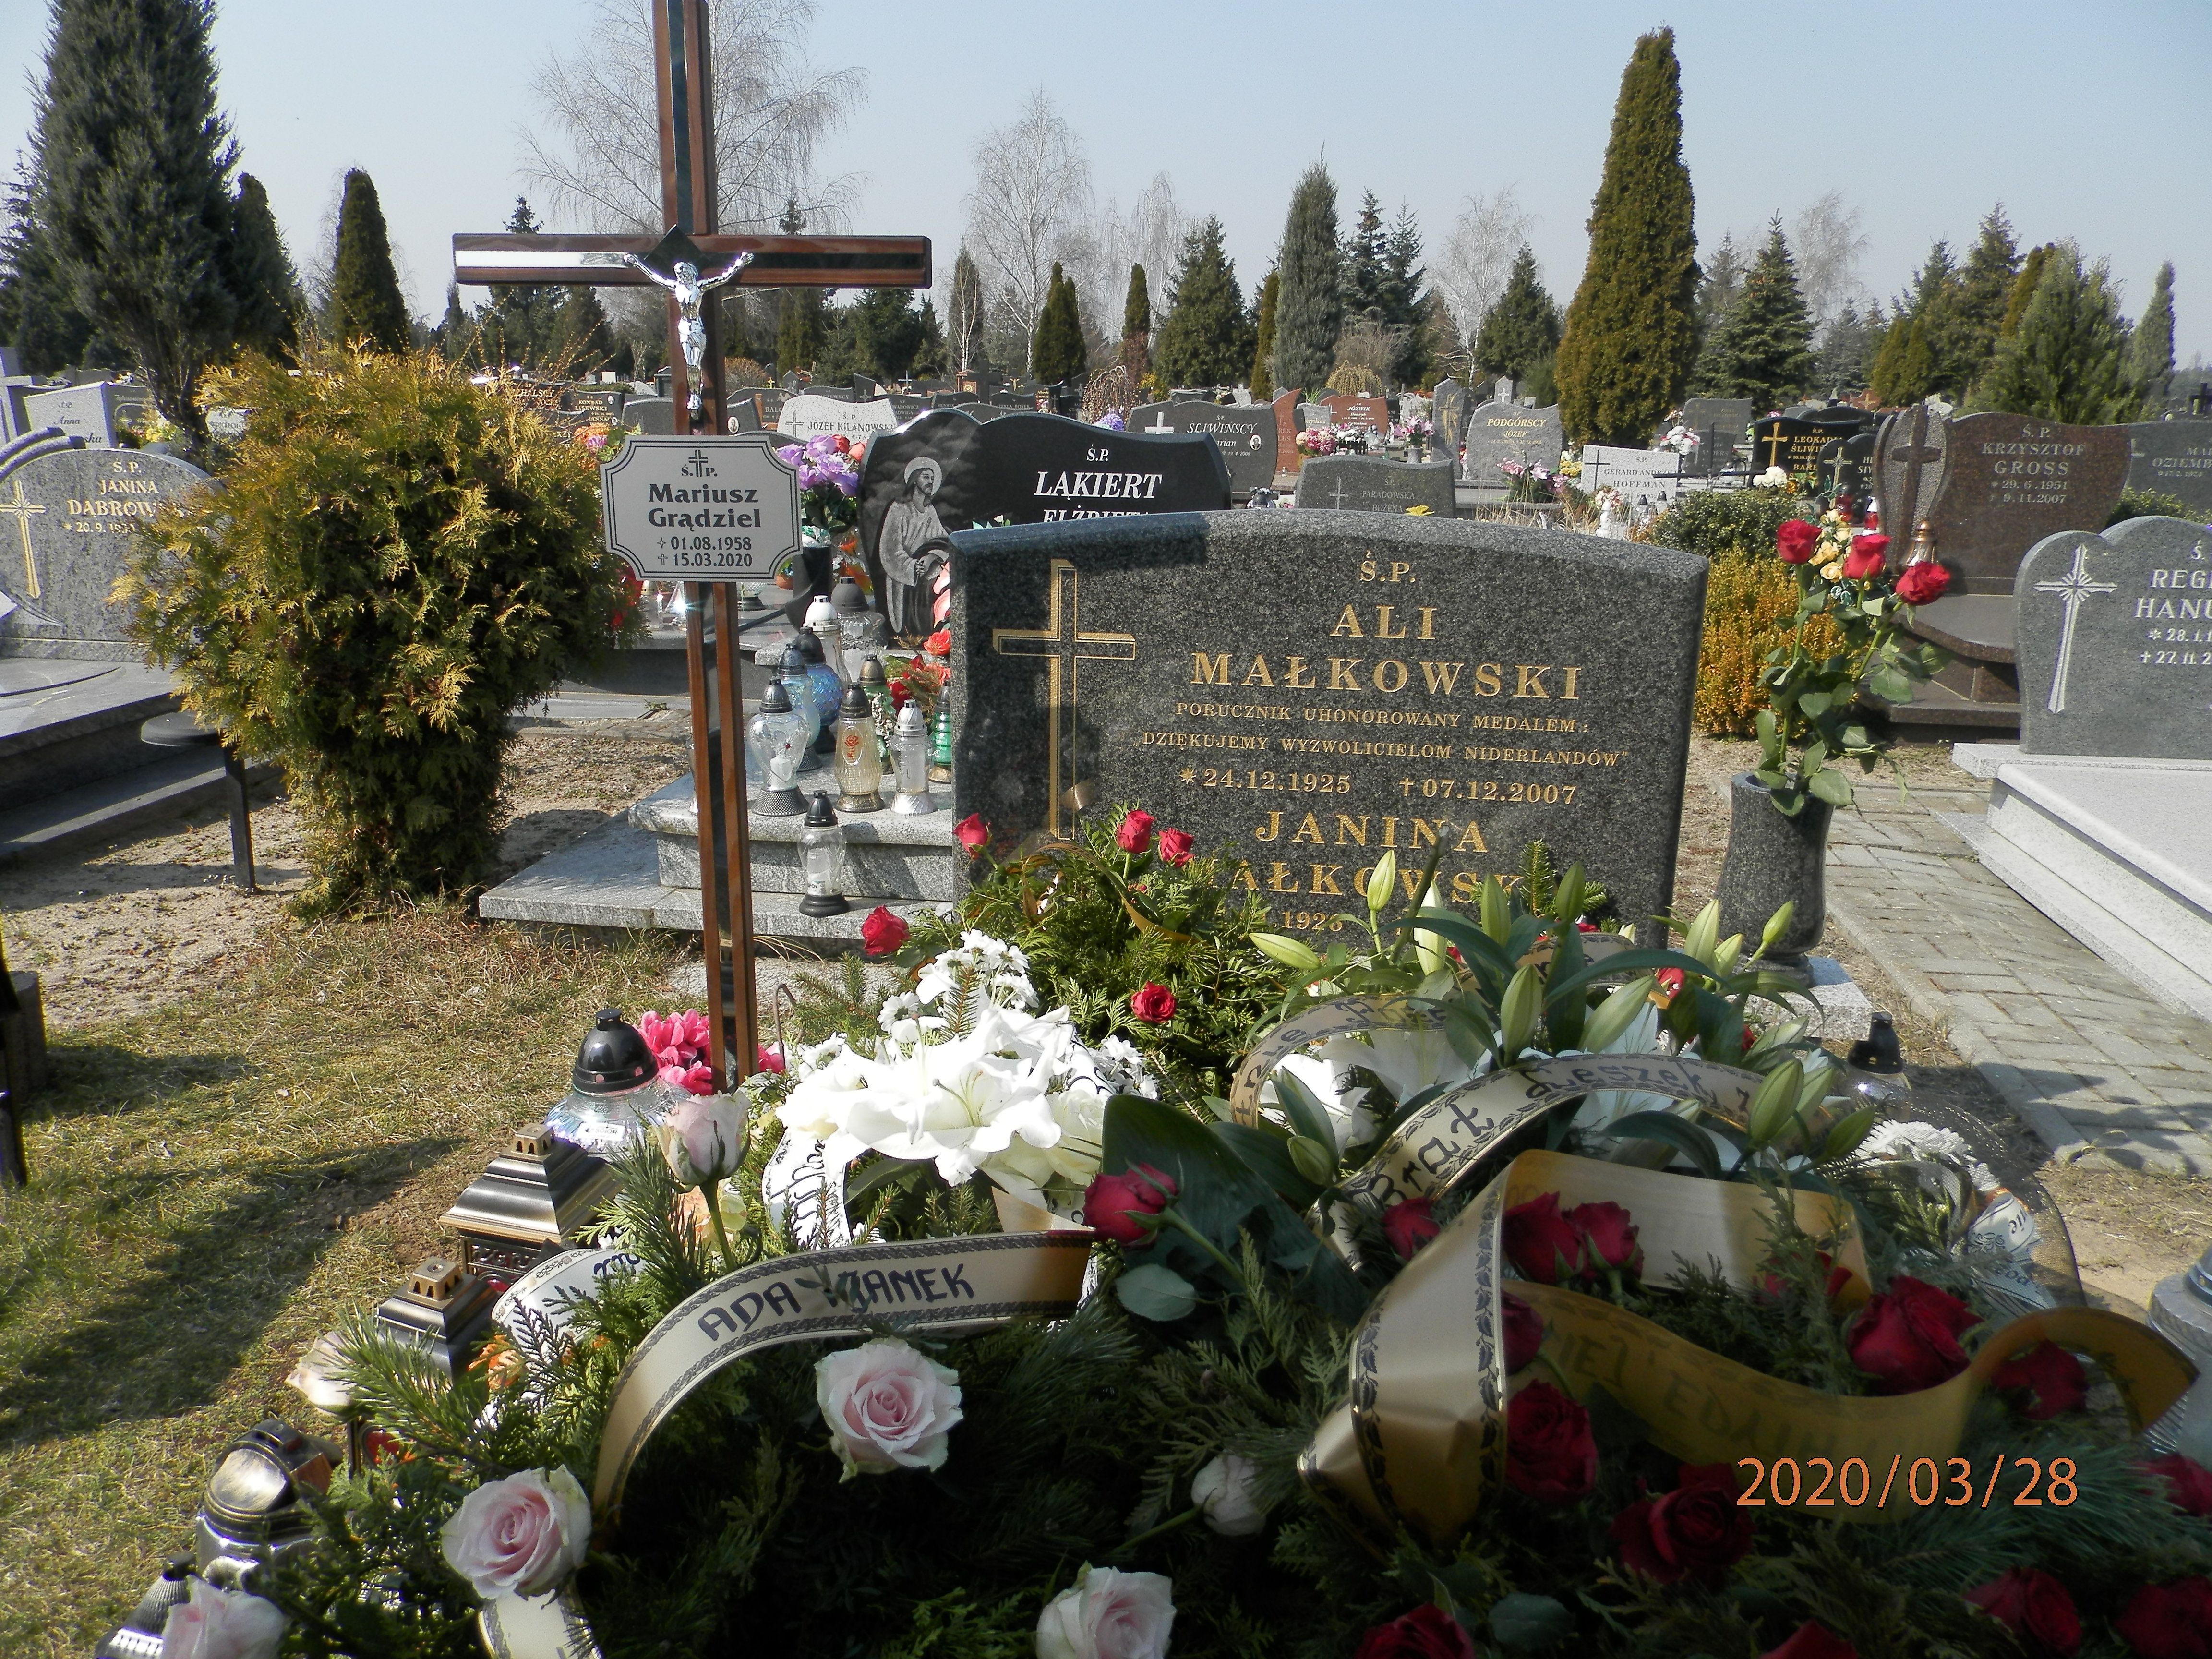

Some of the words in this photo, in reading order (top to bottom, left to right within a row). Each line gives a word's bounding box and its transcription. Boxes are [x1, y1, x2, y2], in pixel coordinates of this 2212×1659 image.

[54, 416, 80, 425] Anna
[807, 420, 834, 431] JÓZEF
[1487, 417, 1547, 427] PODGÓRSCY
[1503, 429, 1527, 437] JÓZEF
[1216, 440, 1237, 448] arian
[1981, 443, 2085, 456] KRZYSZTOF
[1994, 460, 2068, 475] GROSS
[100, 480, 159, 495] JANINA
[1613, 480, 1666, 488] HOFFMAN
[649, 484, 759, 503] Mariusz
[1362, 490, 1415, 500] PARADOWSKA
[648, 508, 761, 532] Grądziel
[670, 536, 752, 551] 01.08.1958
[673, 553, 753, 567] 15.03.2020
[1329, 603, 1437, 640] ALI
[1190, 652, 1582, 700] MAŁKOWSKI
[1175, 702, 1291, 721] PORUCZNIK
[1303, 707, 1461, 729] UHONOROWANY
[1281, 737, 1451, 760] WYZWOLICIELOM
[1202, 768, 1351, 794] 24.12.1925
[1422, 777, 1577, 805] 07.12.2007
[1255, 811, 1489, 853] JANINA
[697, 1281, 803, 1341] ADA
